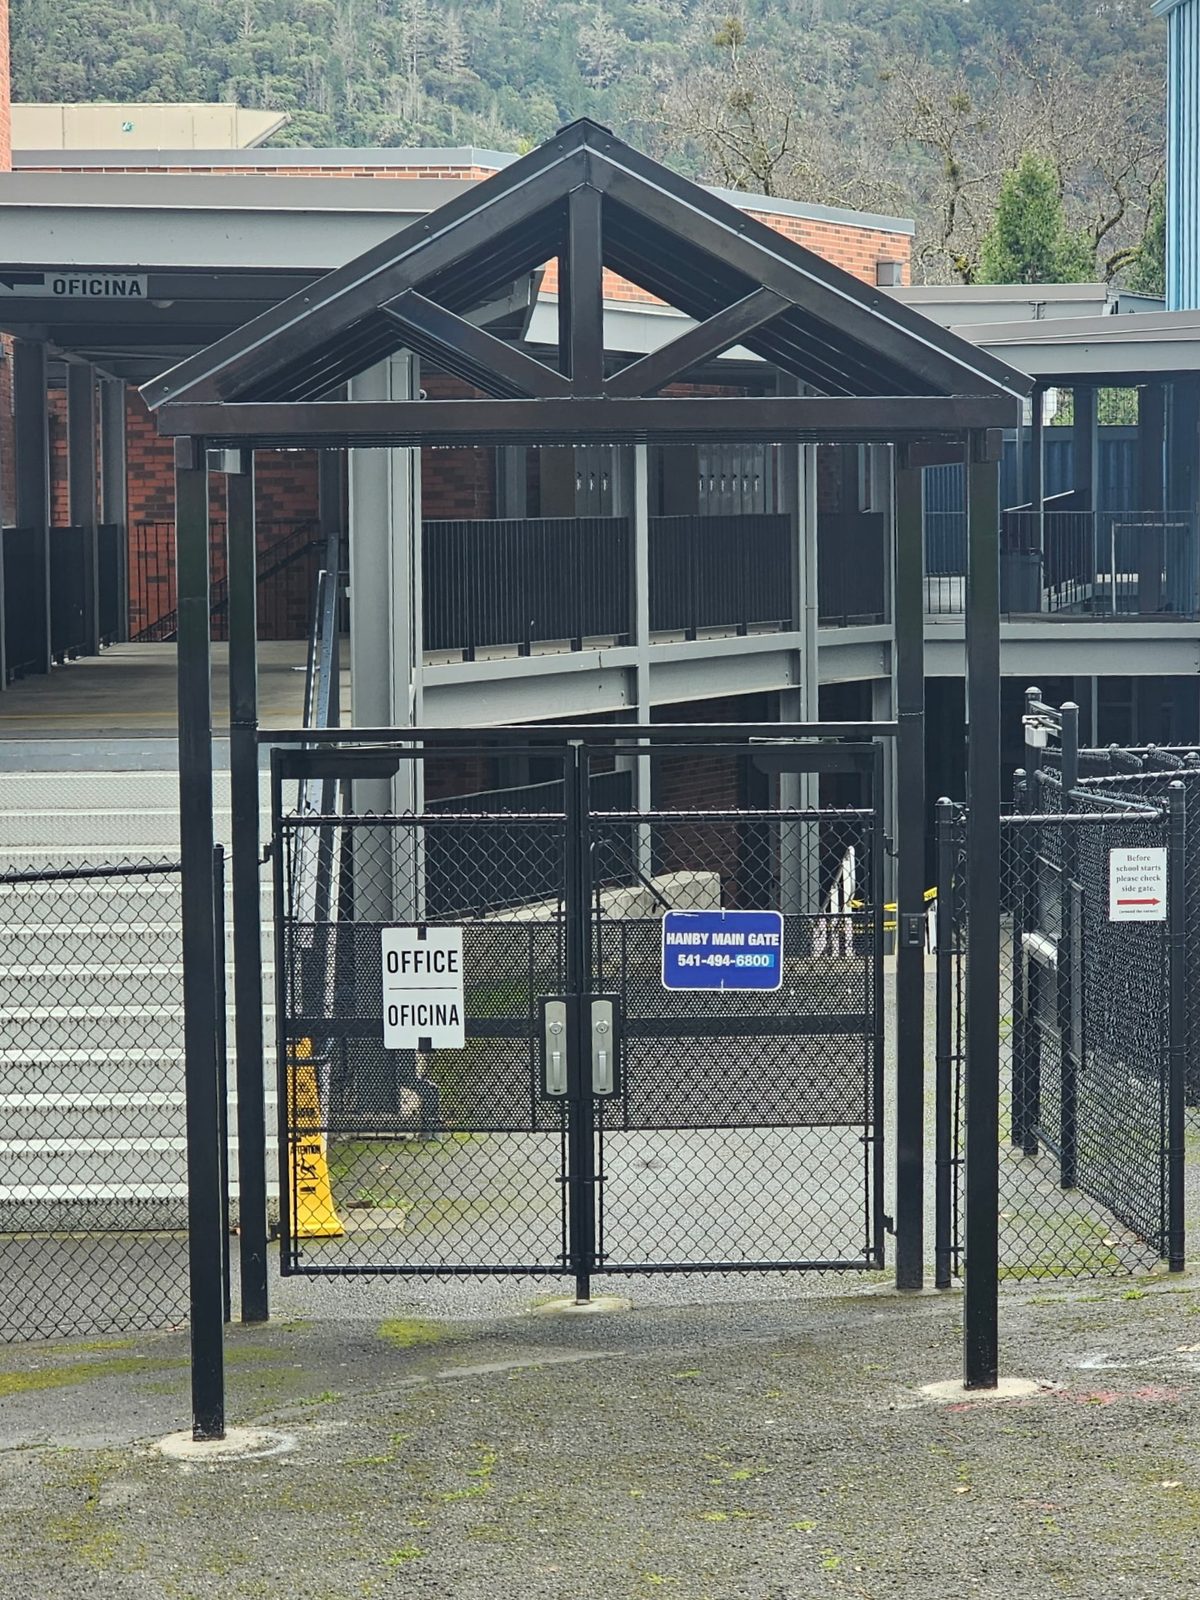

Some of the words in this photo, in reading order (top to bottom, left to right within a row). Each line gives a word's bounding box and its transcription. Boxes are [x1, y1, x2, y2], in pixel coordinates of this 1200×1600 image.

[53, 279, 142, 296] OFICINA
[1116, 875, 1138, 883] please
[666, 933, 709, 945] HANBY
[711, 933, 744, 945] MAIN
[748, 933, 779, 946] GATE
[387, 950, 458, 973] OFFICE
[677, 954, 770, 967] 541-494-6800
[388, 1004, 460, 1026] OFICINA
